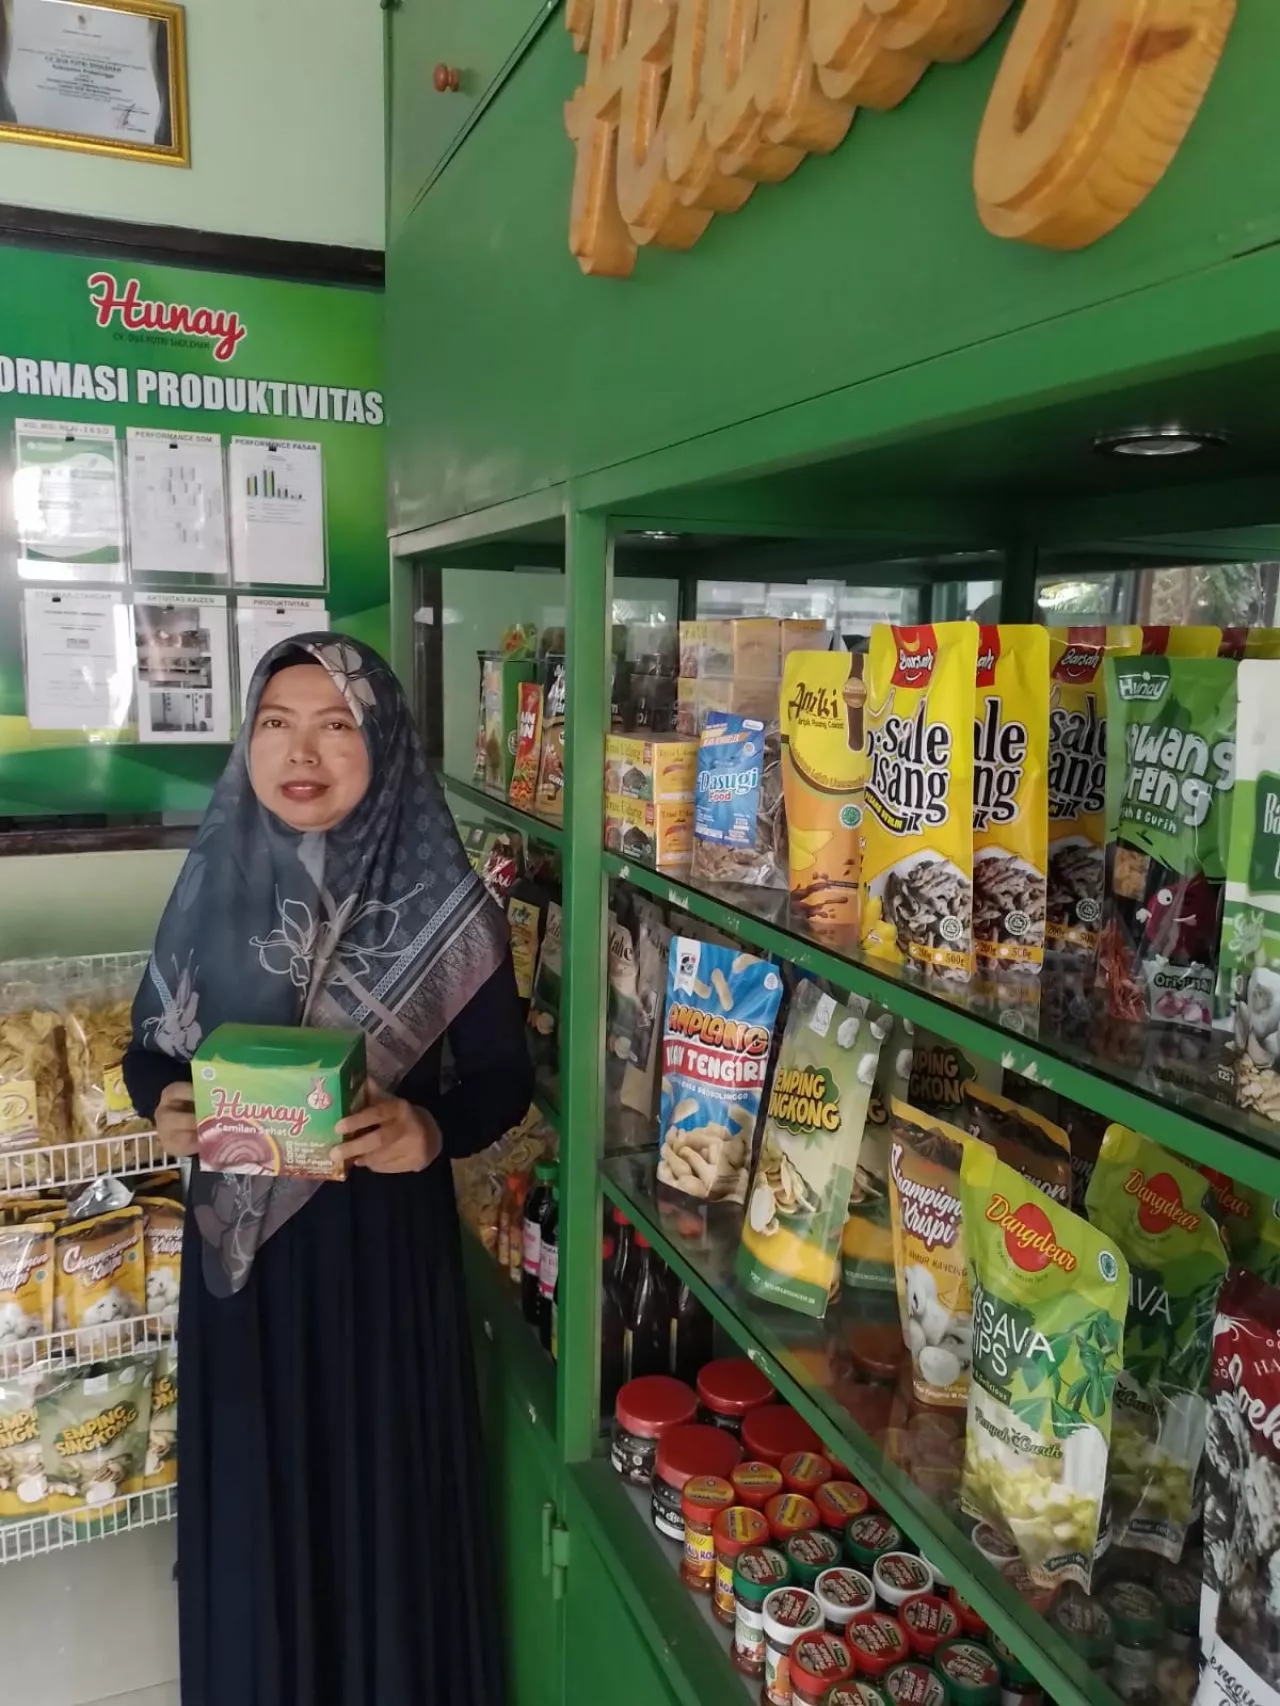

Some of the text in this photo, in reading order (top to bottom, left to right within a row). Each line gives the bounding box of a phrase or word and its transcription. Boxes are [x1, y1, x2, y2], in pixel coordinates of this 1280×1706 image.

[88, 272, 246, 361] Hunay
[137, 369, 384, 426] PRODUKTIVITAS
[253, 598, 311, 609] PRODUKTIVITAS
[1119, 678, 1168, 699] Hunay
[699, 767, 758, 795] Dasugi
[668, 1003, 769, 1055] AMPLANG
[687, 1049, 768, 1083] TENGIRI
[210, 1087, 311, 1137] Hunay
[215, 1122, 257, 1135] Camilan
[903, 1197, 955, 1247] Krispi
[1123, 1168, 1202, 1232] Dangdeur
[984, 1193, 1078, 1273] Dangdeur
[55, 1409, 137, 1457] SINGKONG
[62, 1406, 126, 1440] EMPING
